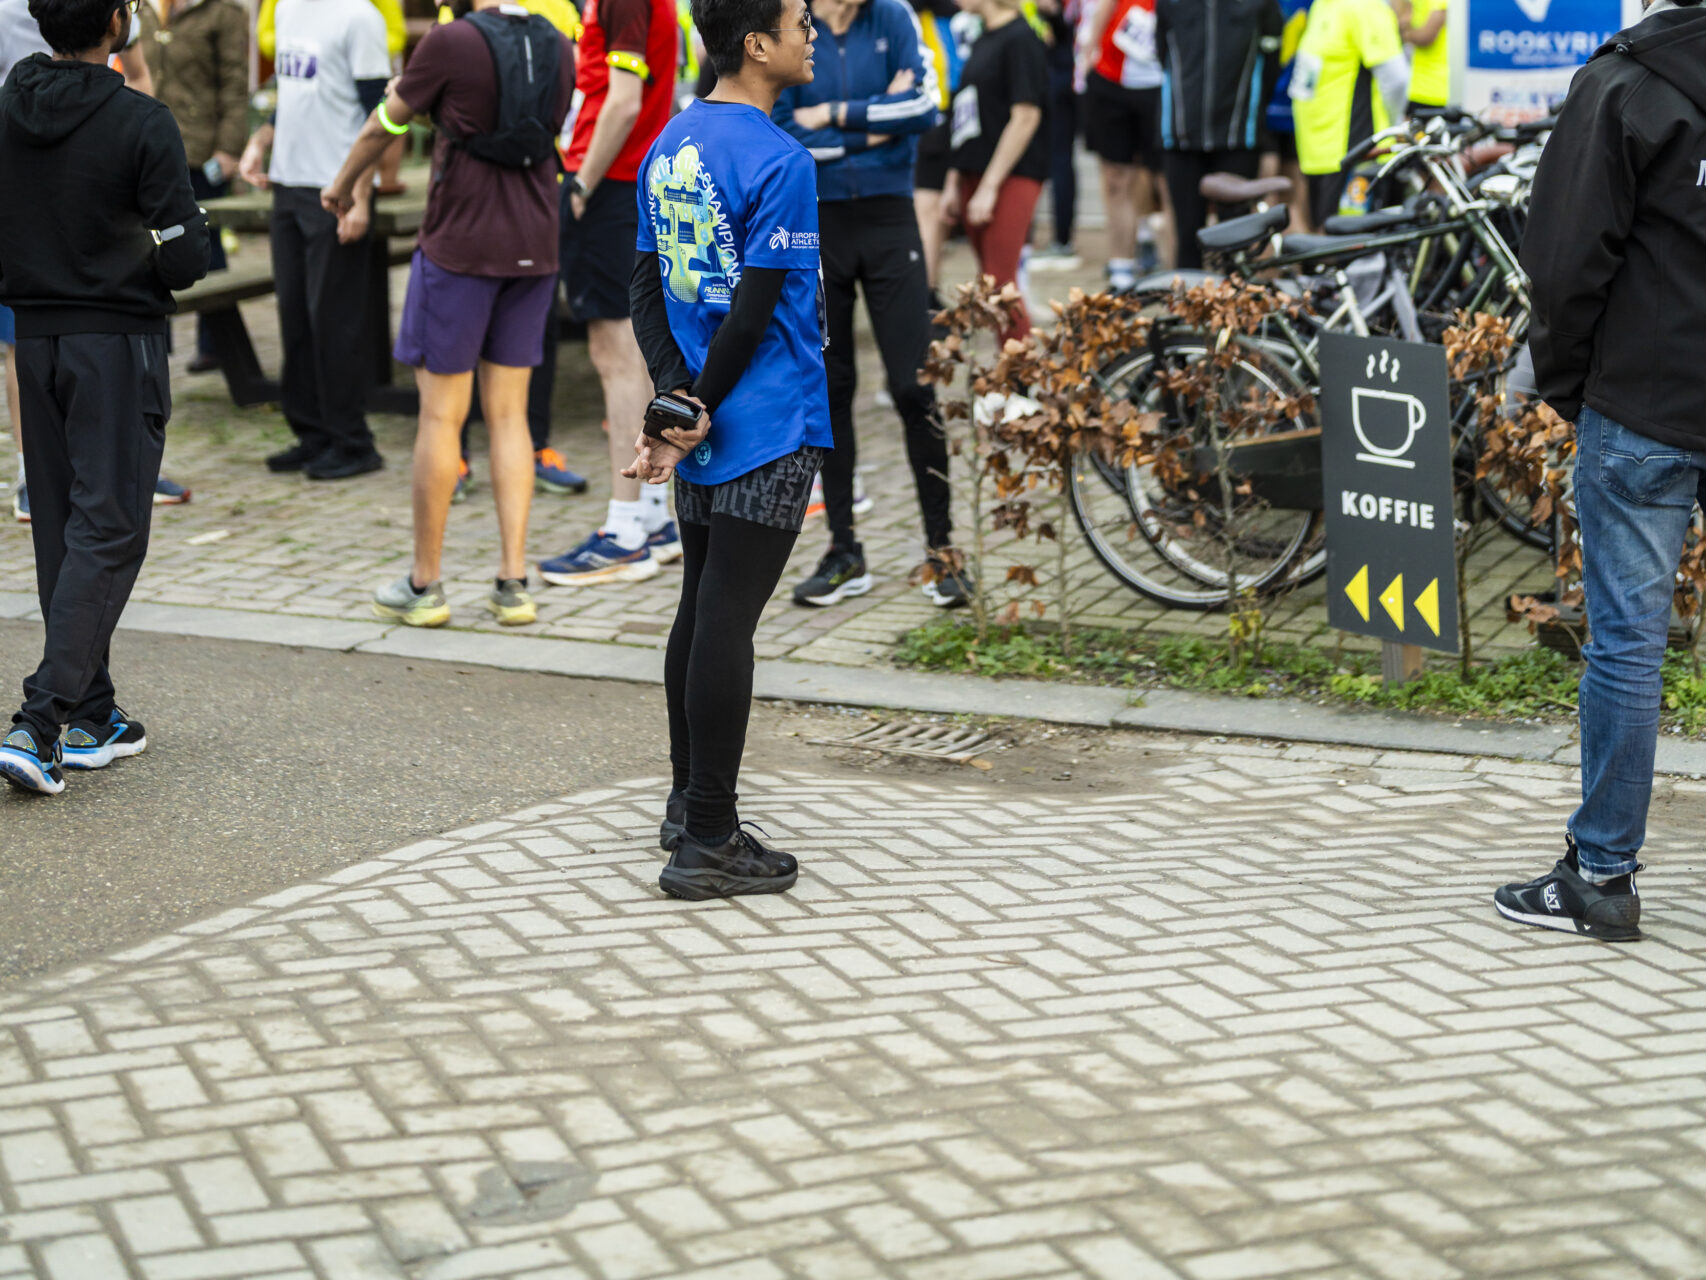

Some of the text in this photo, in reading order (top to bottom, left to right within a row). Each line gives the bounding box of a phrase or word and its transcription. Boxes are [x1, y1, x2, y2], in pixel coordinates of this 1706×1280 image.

[702, 172, 742, 289] CHAMPIONS
[1341, 489, 1435, 530] KOFFIE
[1544, 883, 1561, 910] EA7
